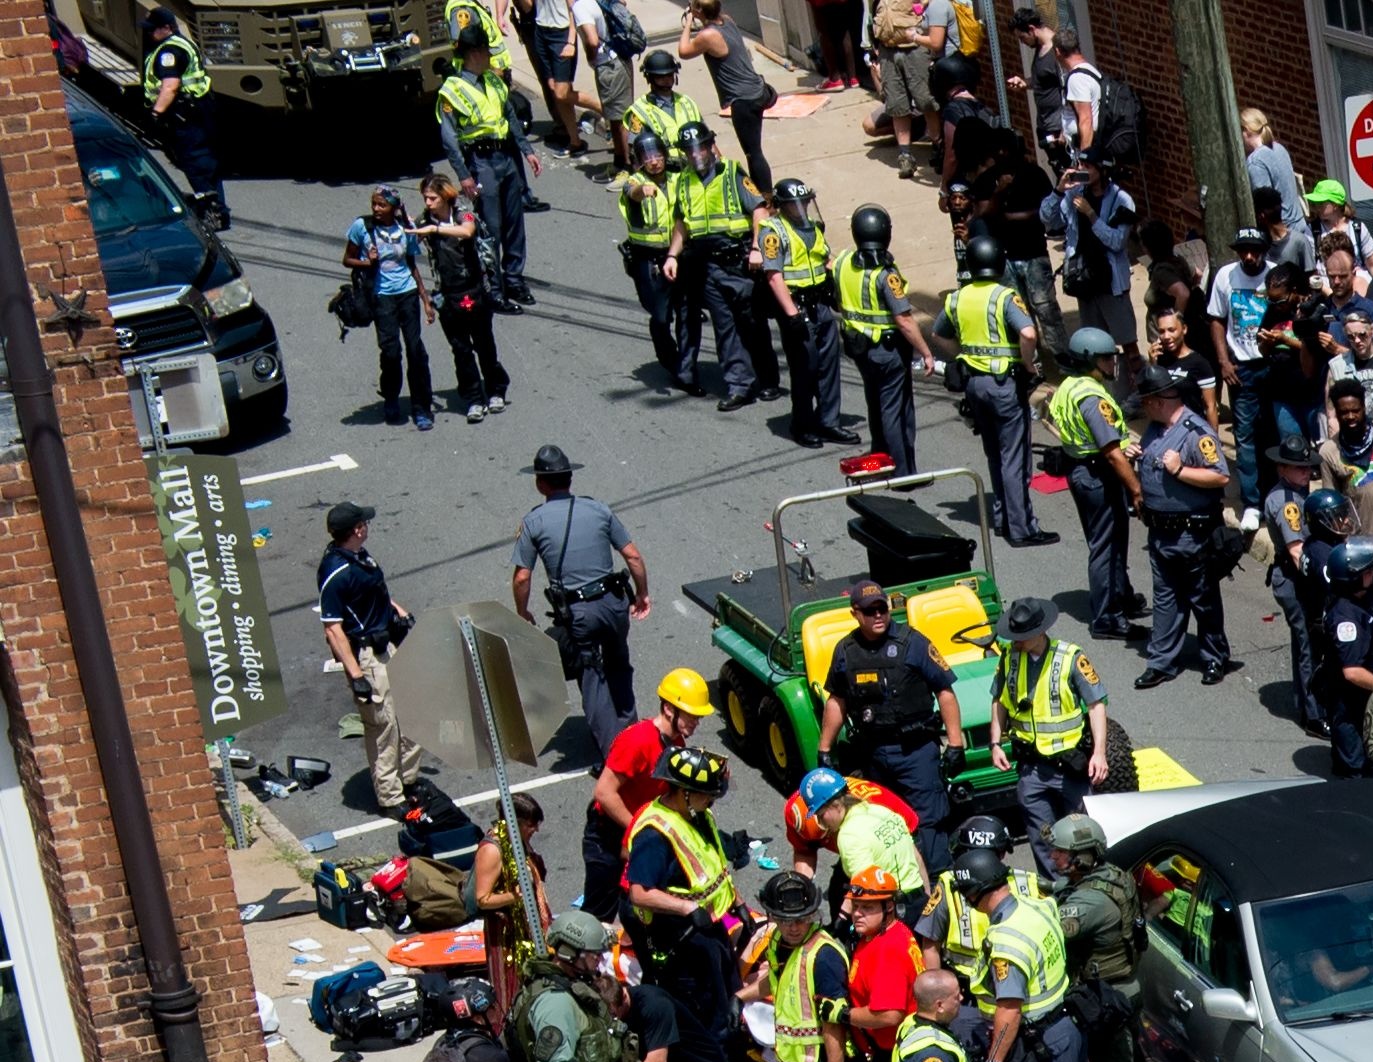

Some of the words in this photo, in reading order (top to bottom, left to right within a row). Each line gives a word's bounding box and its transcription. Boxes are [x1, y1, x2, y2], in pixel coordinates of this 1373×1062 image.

[159, 465, 204, 543] Mall
[203, 473, 225, 513] arts
[215, 533, 240, 597] dining
[185, 547, 241, 725] Downtown
[233, 615, 264, 702] shopping
[1051, 662, 1061, 705] POLICE
[968, 829, 996, 845] VSP
